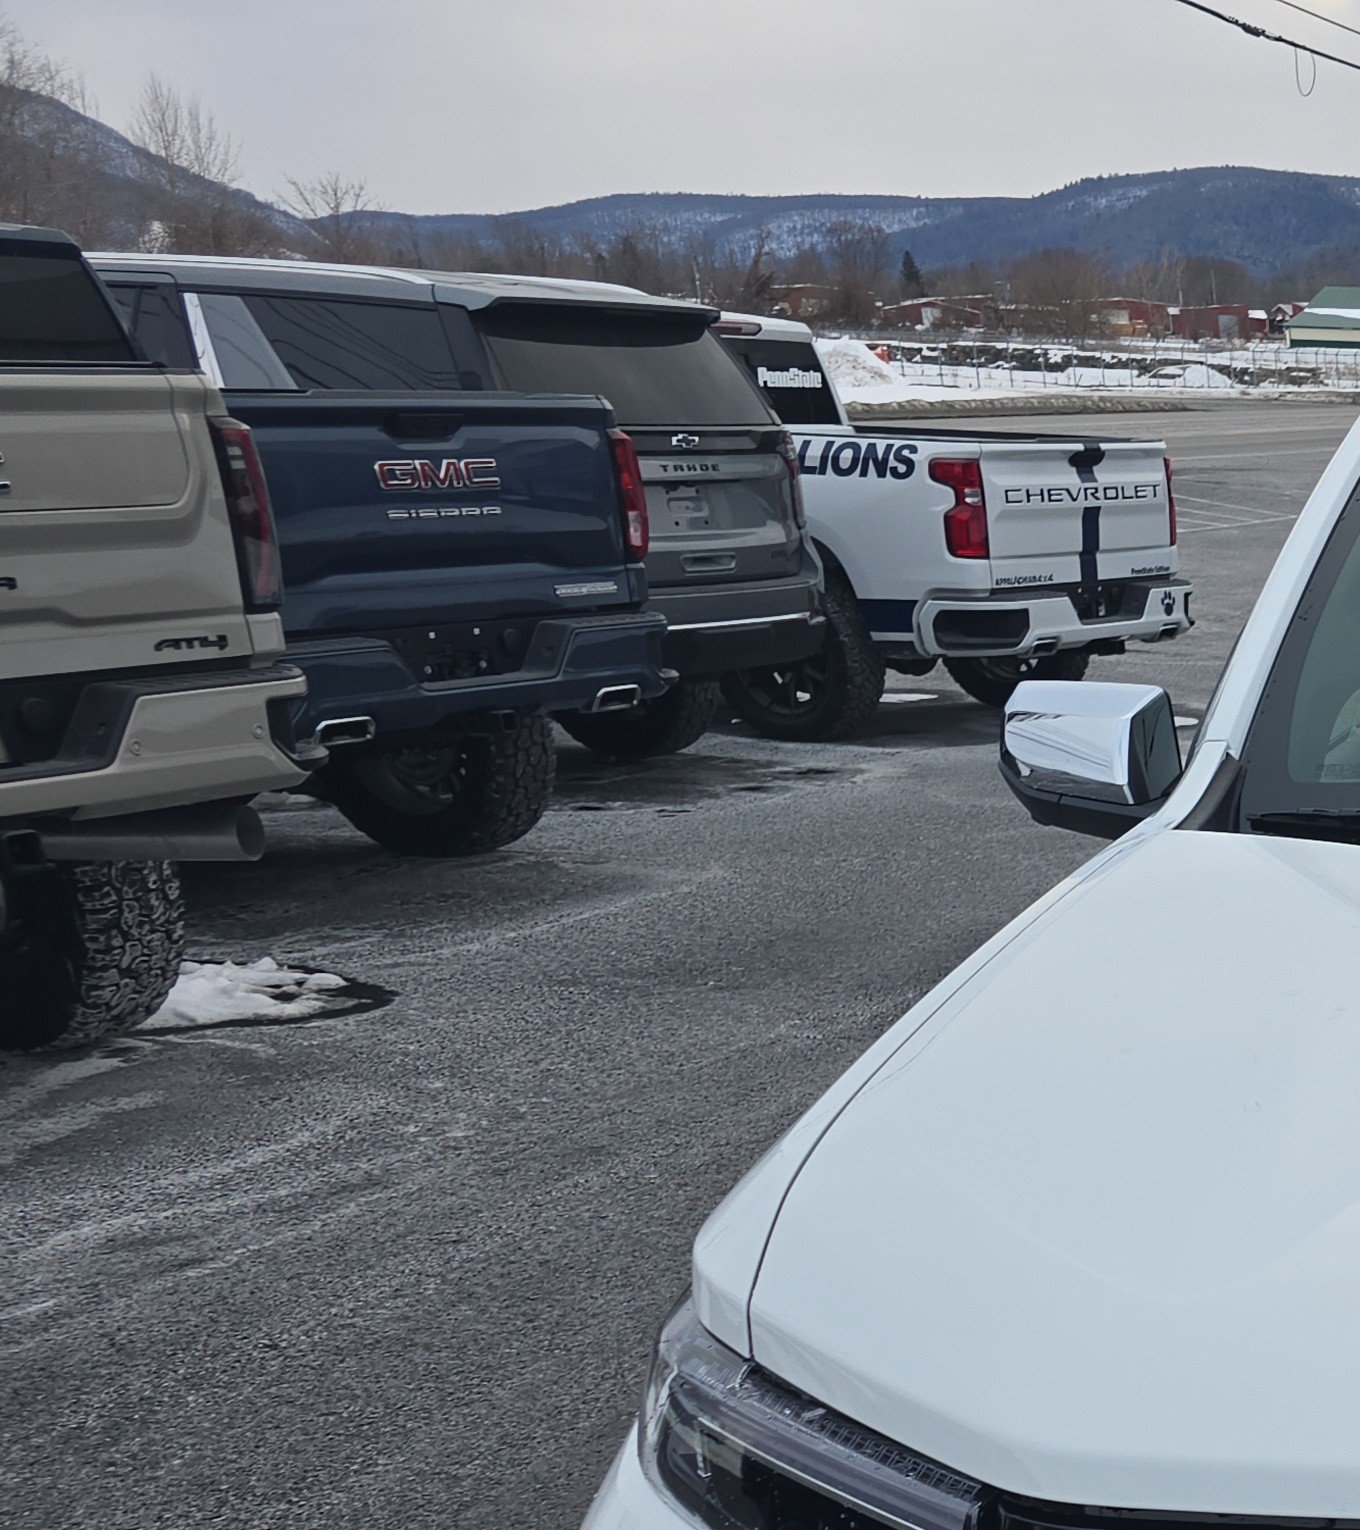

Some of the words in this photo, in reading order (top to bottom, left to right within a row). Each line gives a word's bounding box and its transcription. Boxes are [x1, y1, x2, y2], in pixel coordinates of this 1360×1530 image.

[659, 463, 720, 473] TAHOE
[797, 439, 919, 480] LIONS
[374, 458, 501, 490] GMC
[1004, 484, 1161, 504] CHEVROLET
[153, 634, 229, 652] AT4
